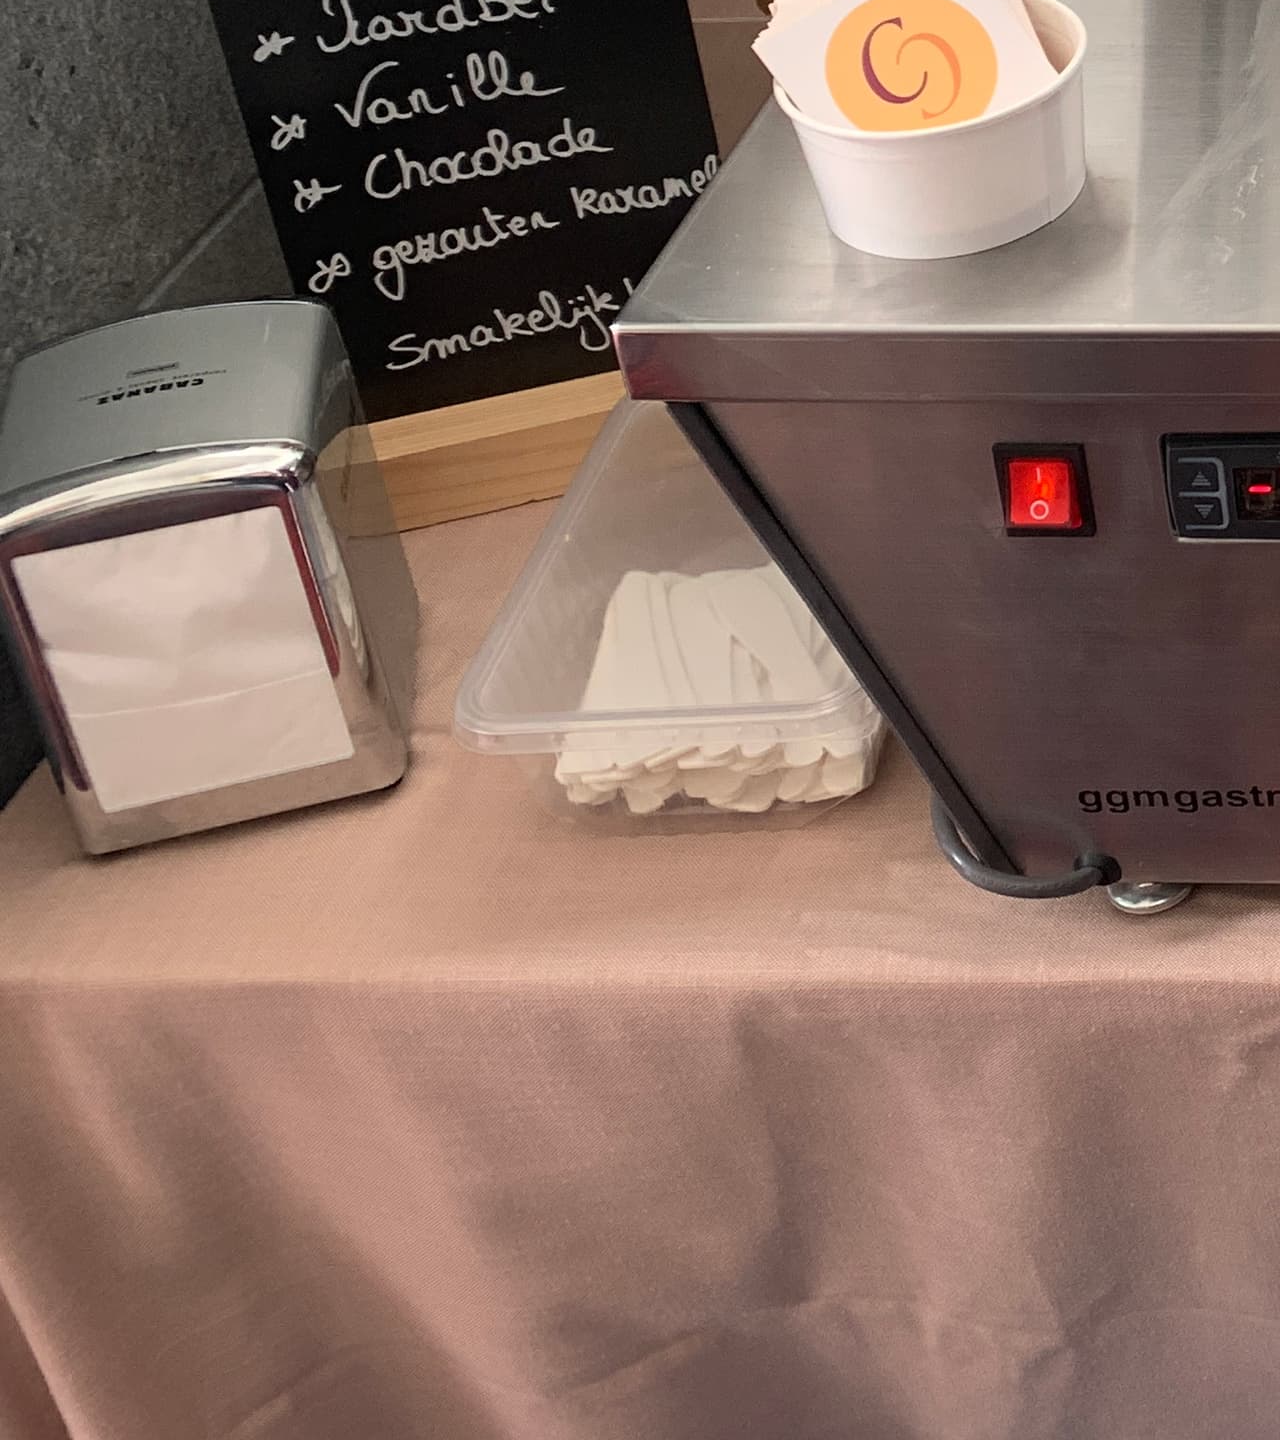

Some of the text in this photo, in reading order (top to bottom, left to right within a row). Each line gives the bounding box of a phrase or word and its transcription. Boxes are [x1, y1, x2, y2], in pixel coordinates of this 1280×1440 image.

[333, 49, 567, 128] Vanille
[364, 117, 615, 199] Chocolade
[372, 206, 561, 301] gezouten
